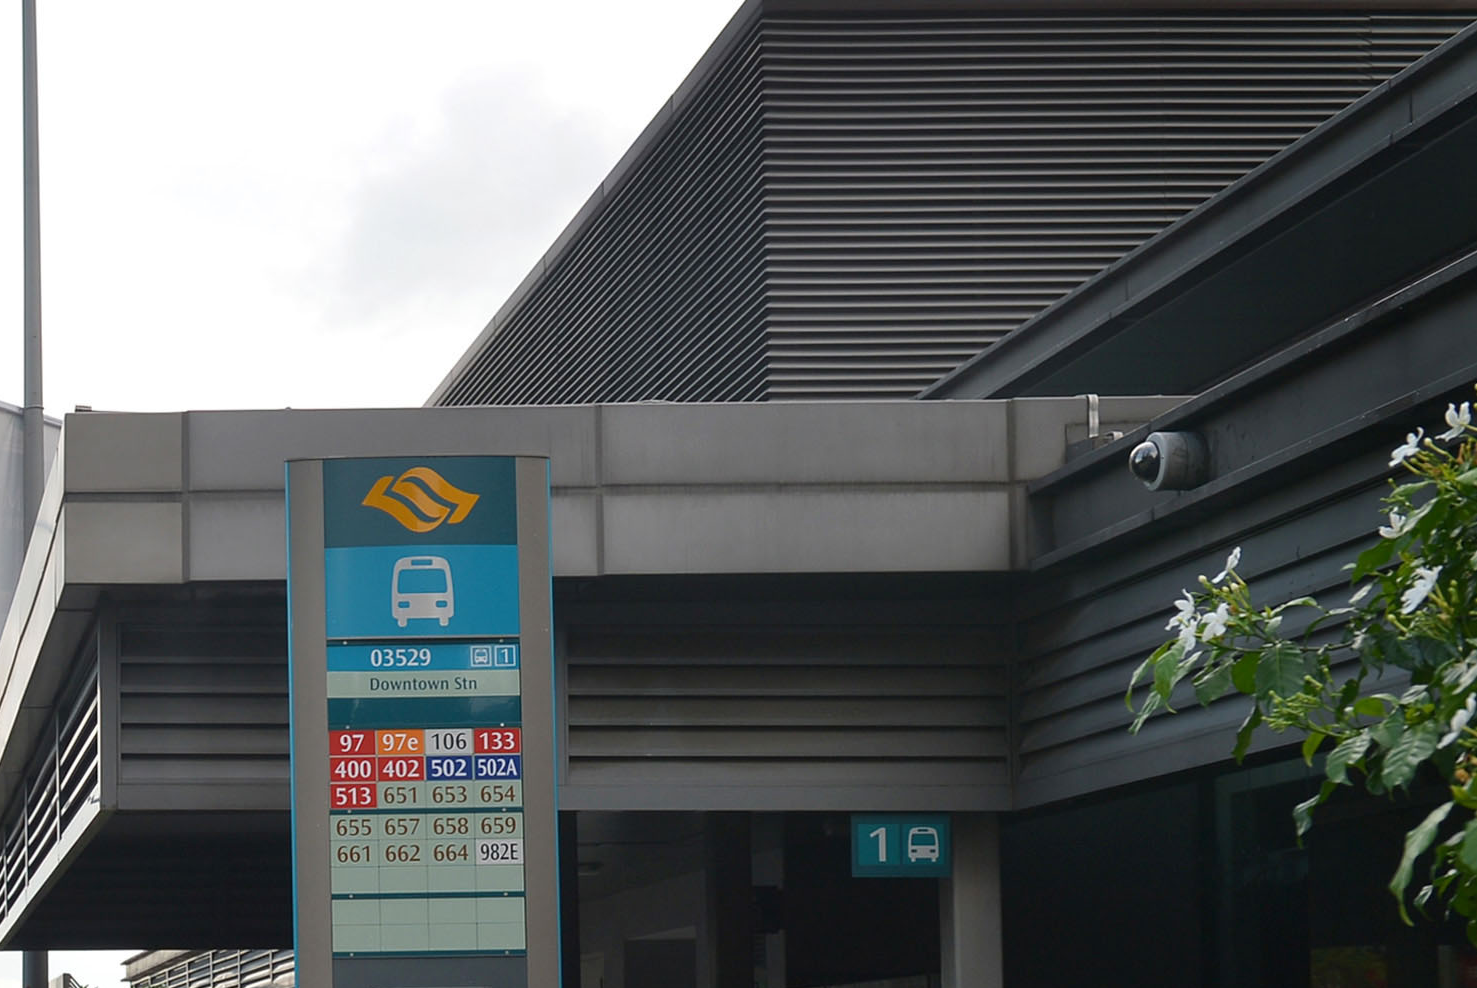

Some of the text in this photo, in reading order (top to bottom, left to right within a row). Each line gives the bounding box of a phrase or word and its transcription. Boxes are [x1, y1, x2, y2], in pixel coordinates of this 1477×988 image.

[370, 649, 432, 667] 03529
[369, 676, 478, 692] Downtown Stn
[339, 733, 515, 753] 97 97e 106 133
[335, 758, 517, 779] 400 402 502 502A
[335, 785, 516, 805] 513 651 653 654
[336, 817, 517, 837] 655 657 658 659
[337, 843, 519, 863] 661 662 664 982E
[869, 826, 887, 862] 1
